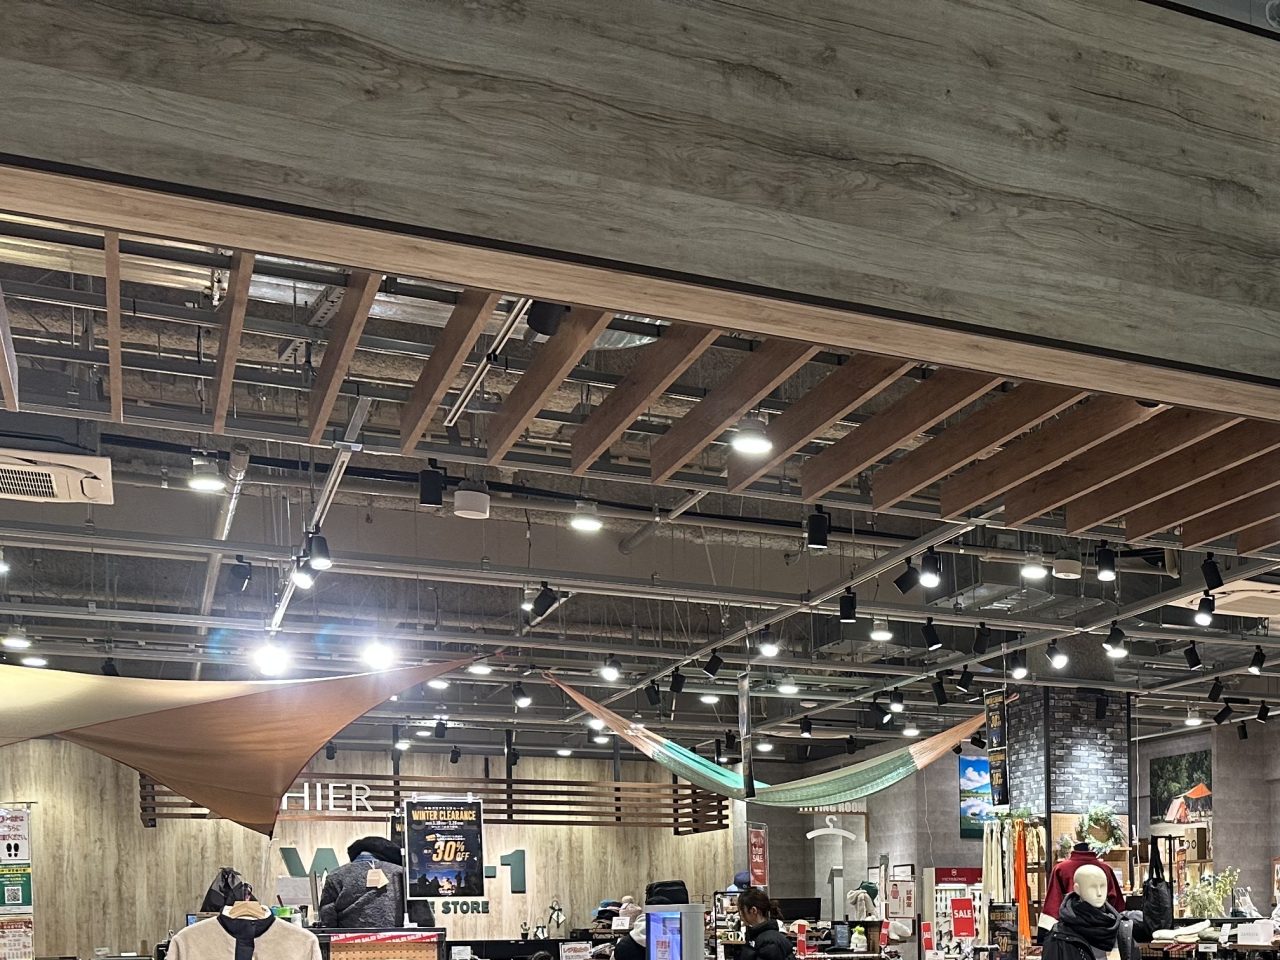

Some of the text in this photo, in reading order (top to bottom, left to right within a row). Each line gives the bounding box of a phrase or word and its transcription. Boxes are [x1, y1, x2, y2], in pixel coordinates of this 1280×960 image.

[411, 810, 476, 821] WINTER CLEARANCE
[441, 900, 490, 914] STORE
[954, 909, 972, 919] SALE
